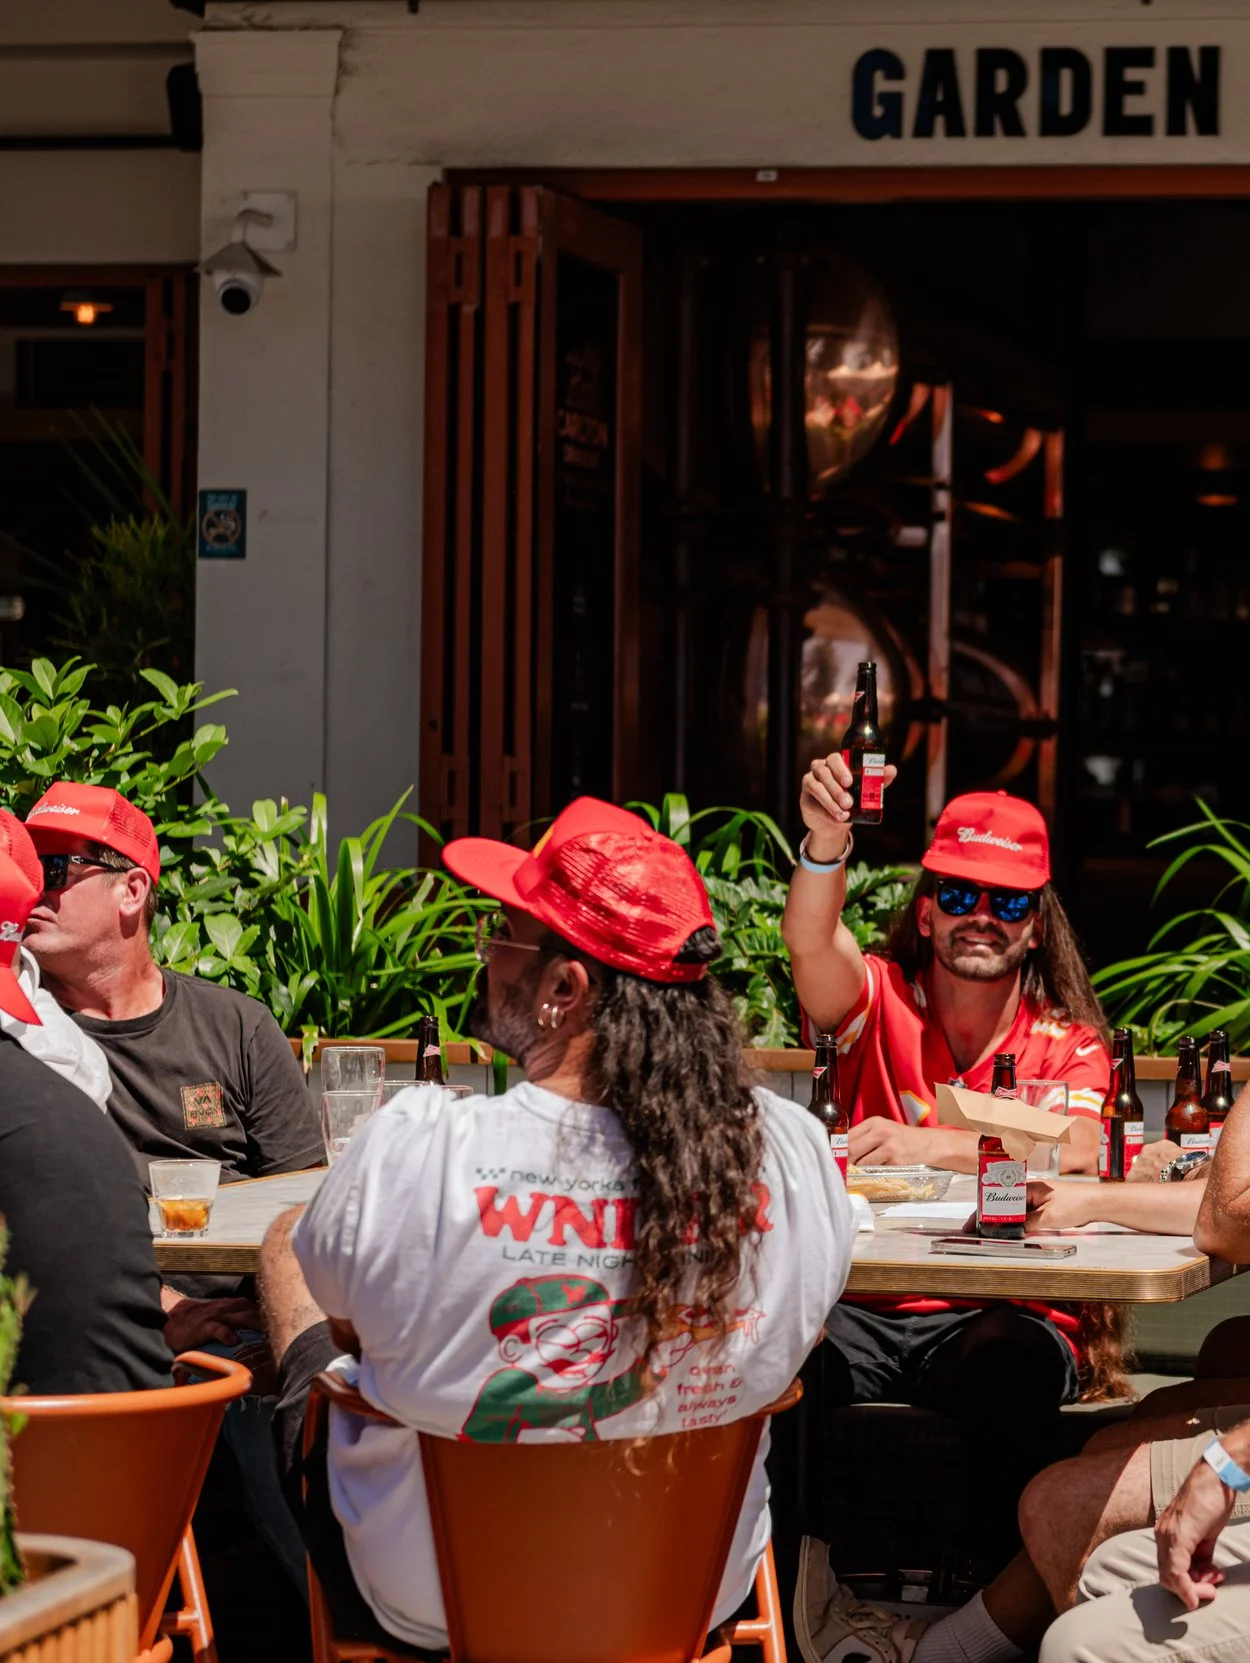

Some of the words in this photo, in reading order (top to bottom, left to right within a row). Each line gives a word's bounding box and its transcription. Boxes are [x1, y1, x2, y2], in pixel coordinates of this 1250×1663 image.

[851, 46, 1221, 140] GARDEN
[957, 826, 1023, 851] Budweiser
[510, 1170, 556, 1186] new
[502, 1245, 566, 1266] LATE
[577, 1253, 637, 1270] NIGH
